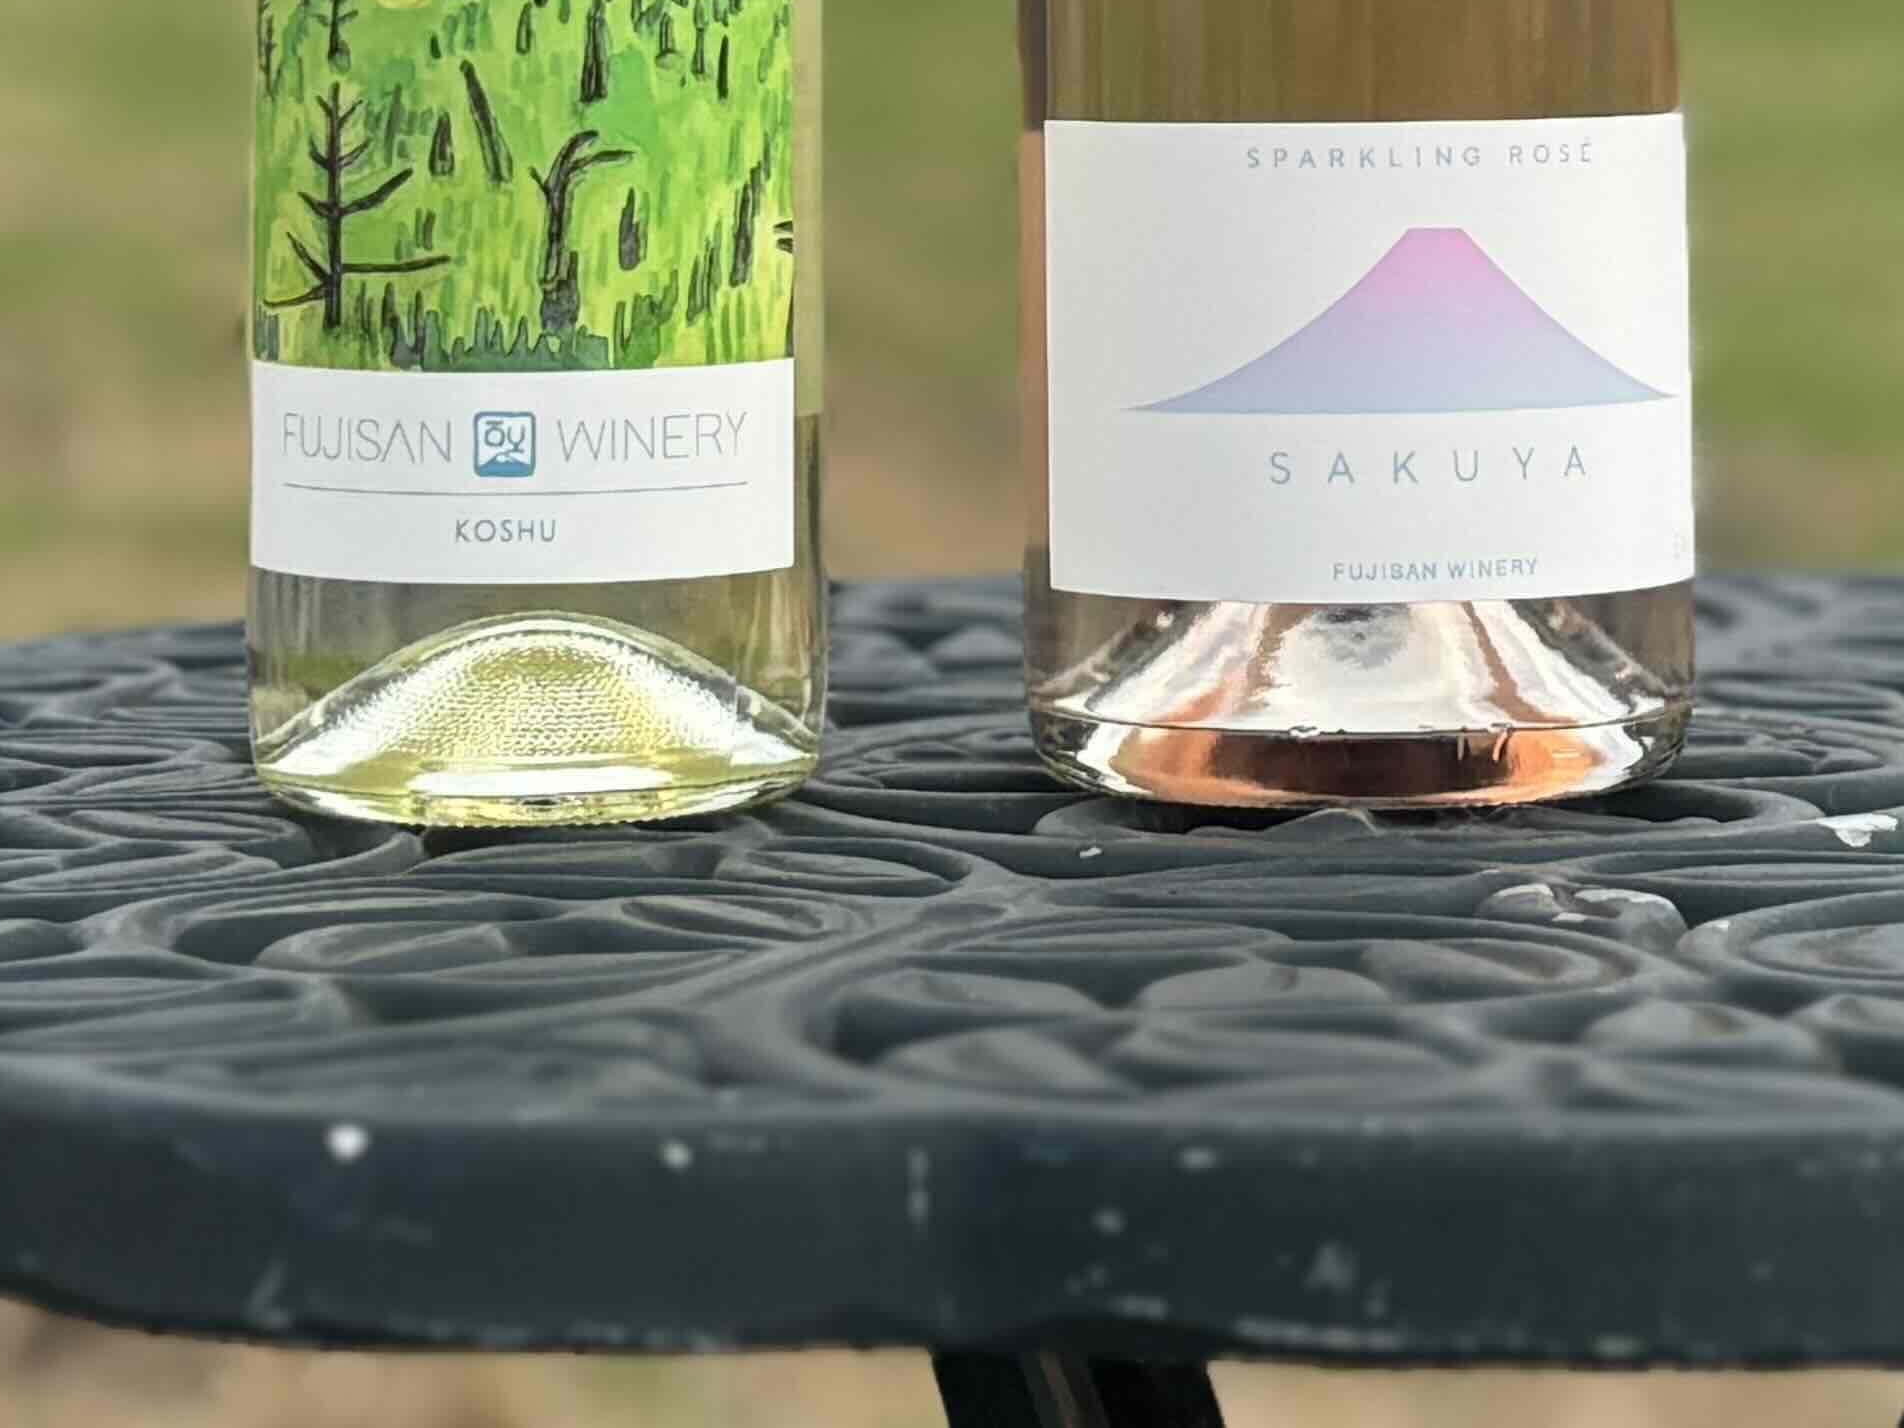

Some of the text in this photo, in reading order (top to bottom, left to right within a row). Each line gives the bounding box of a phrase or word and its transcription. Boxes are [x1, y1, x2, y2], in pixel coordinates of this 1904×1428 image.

[1246, 137, 1593, 169] SPARKLING ROSÉ
[283, 411, 748, 464] FUJISAN WINERY
[1269, 445, 1587, 485] SAKUYA
[455, 519, 557, 544] KOSHU
[1332, 558, 1537, 581] FUJISAN WINERY
